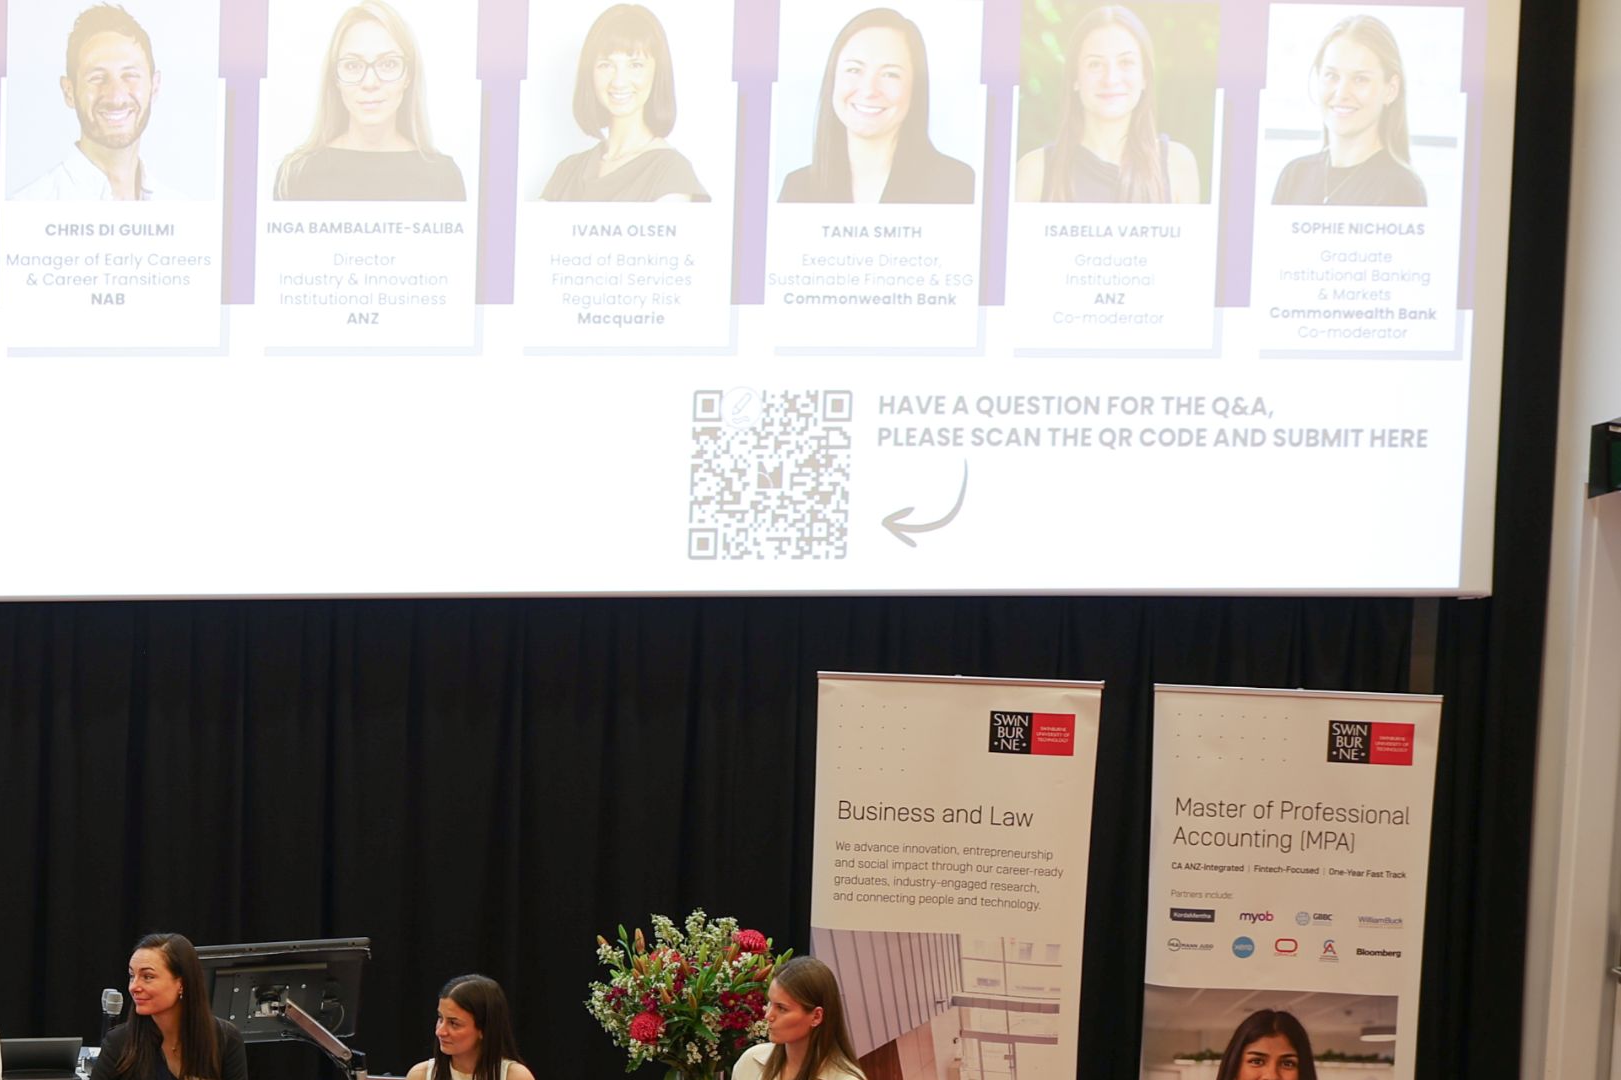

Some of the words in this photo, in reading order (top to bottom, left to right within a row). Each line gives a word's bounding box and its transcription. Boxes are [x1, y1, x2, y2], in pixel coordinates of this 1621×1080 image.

[1291, 221, 1344, 234] SOPHIE
[1348, 222, 1425, 235] NICHOLAS
[879, 395, 946, 415] HAVE
[952, 395, 969, 415] A
[975, 395, 1100, 418] QUESTION
[1107, 395, 1154, 415] FOR
[1160, 396, 1205, 415] THE
[1211, 396, 1273, 418] Q&A,
[877, 427, 964, 446] PLEASE
[971, 427, 1040, 446] SCAN
[1047, 427, 1092, 447] THE
[1098, 427, 1132, 450] QR
[1139, 427, 1207, 447] CODE
[1213, 427, 1266, 447] AND
[1273, 428, 1364, 447] SUBMIT
[1369, 428, 1428, 448] HERE
[997, 726, 1025, 739] BUR
[1336, 736, 1363, 748] BUR
[838, 800, 934, 822] Business
[942, 805, 982, 824] and
[990, 806, 1033, 827] Law
[1175, 796, 1246, 818] Master
[1253, 800, 1274, 819] of
[1280, 800, 1409, 825] Professional
[1172, 826, 1292, 853] Accounting
[835, 840, 851, 851] We
[853, 842, 899, 853] advance
[902, 843, 959, 855] innovation,
[962, 846, 1053, 862] entrepreneurship
[834, 857, 855, 869] and
[857, 859, 888, 870] social
[891, 859, 928, 872] impact
[931, 861, 973, 874] through
[975, 864, 993, 873] our
[995, 864, 1064, 879] career-ready
[1171, 862, 1182, 870] CA
[1184, 863, 1244, 873] ANZ-Integrated
[1253, 865, 1319, 874] Fintech-Focused
[1328, 868, 1365, 877] One-Year
[1366, 870, 1384, 878] Fast
[834, 874, 890, 886] graduates,
[893, 876, 987, 891] industry-engaged
[990, 882, 1040, 893] research,
[832, 891, 853, 901] and
[856, 892, 915, 905] connecting
[918, 895, 954, 906] people
[957, 895, 978, 906] and
[980, 897, 1041, 912] technology.
[1239, 911, 1274, 924] myob
[1356, 948, 1401, 958] Bloomberg
